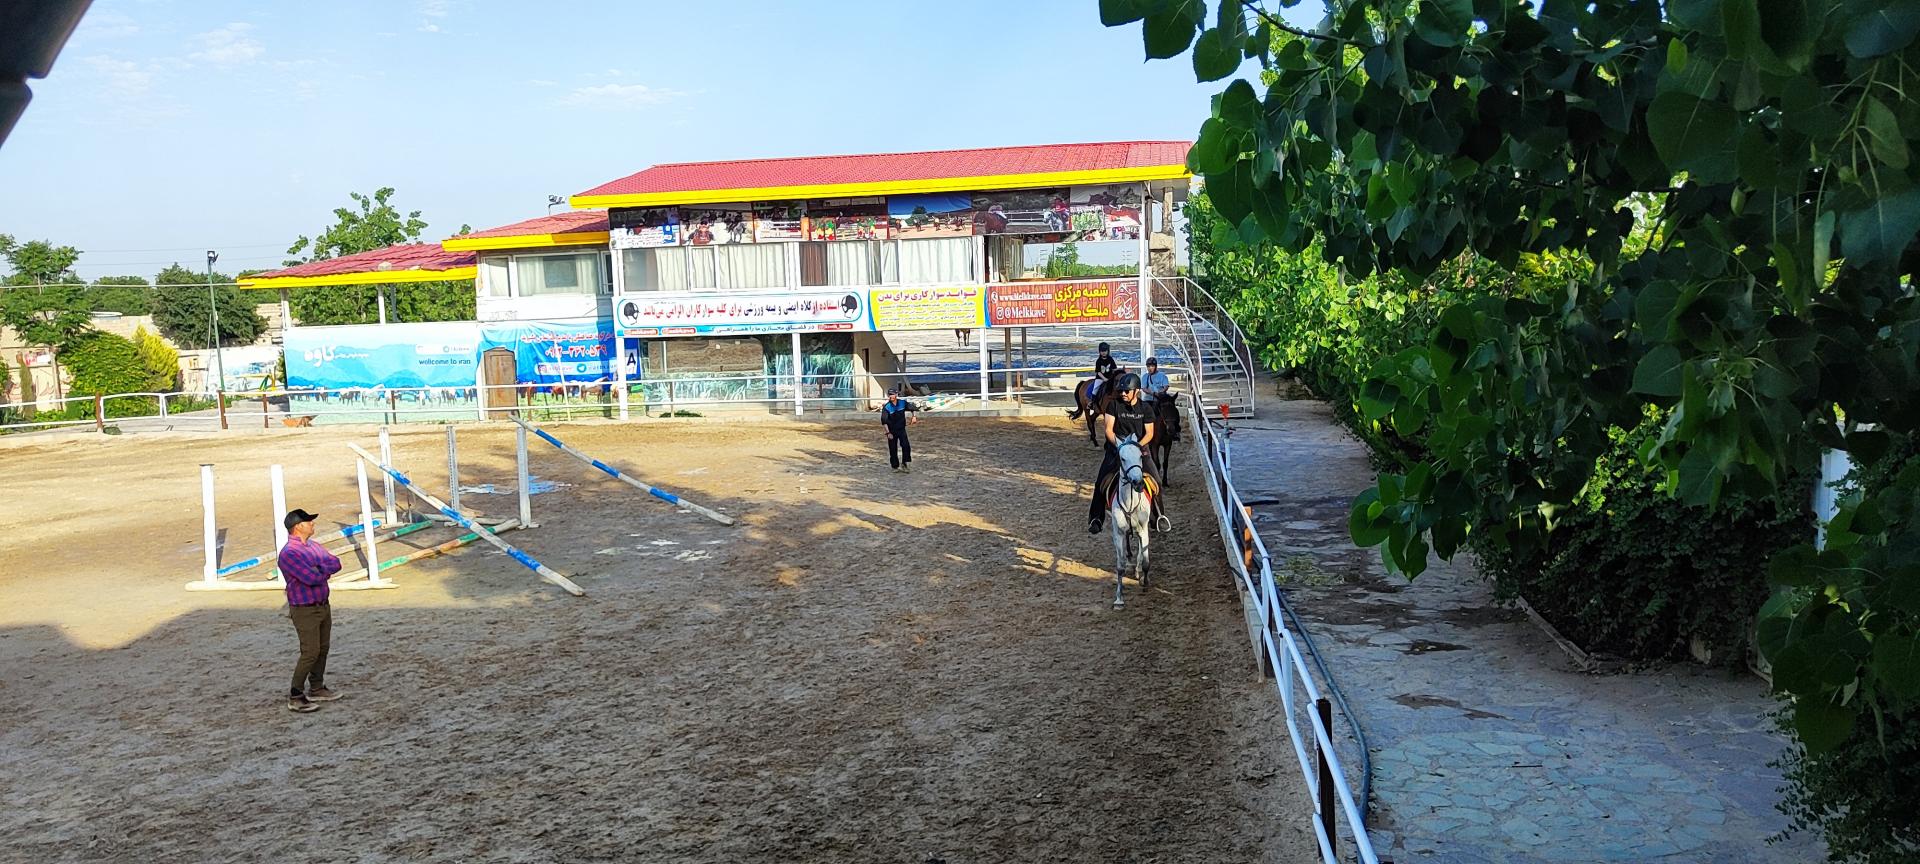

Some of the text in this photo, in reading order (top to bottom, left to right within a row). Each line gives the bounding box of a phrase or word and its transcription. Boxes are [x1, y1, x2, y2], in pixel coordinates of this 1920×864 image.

[878, 293, 892, 302] بدن
[893, 292, 910, 301] برای
[1054, 283, 1109, 302] شعبه مرکزی
[666, 304, 684, 318] الزامی
[716, 303, 727, 316] کلیه
[729, 303, 742, 317] برای
[743, 303, 764, 316] ورزشی
[765, 304, 777, 315] بیمه
[783, 300, 799, 315] ایمنی
[800, 299, 812, 311] کلاه
[812, 301, 819, 315] از
[819, 299, 840, 310] استفاده
[1083, 303, 1109, 317] ملک
[1055, 303, 1082, 322] کاوه
[303, 344, 336, 367] کاوه
[627, 352, 636, 366] A
